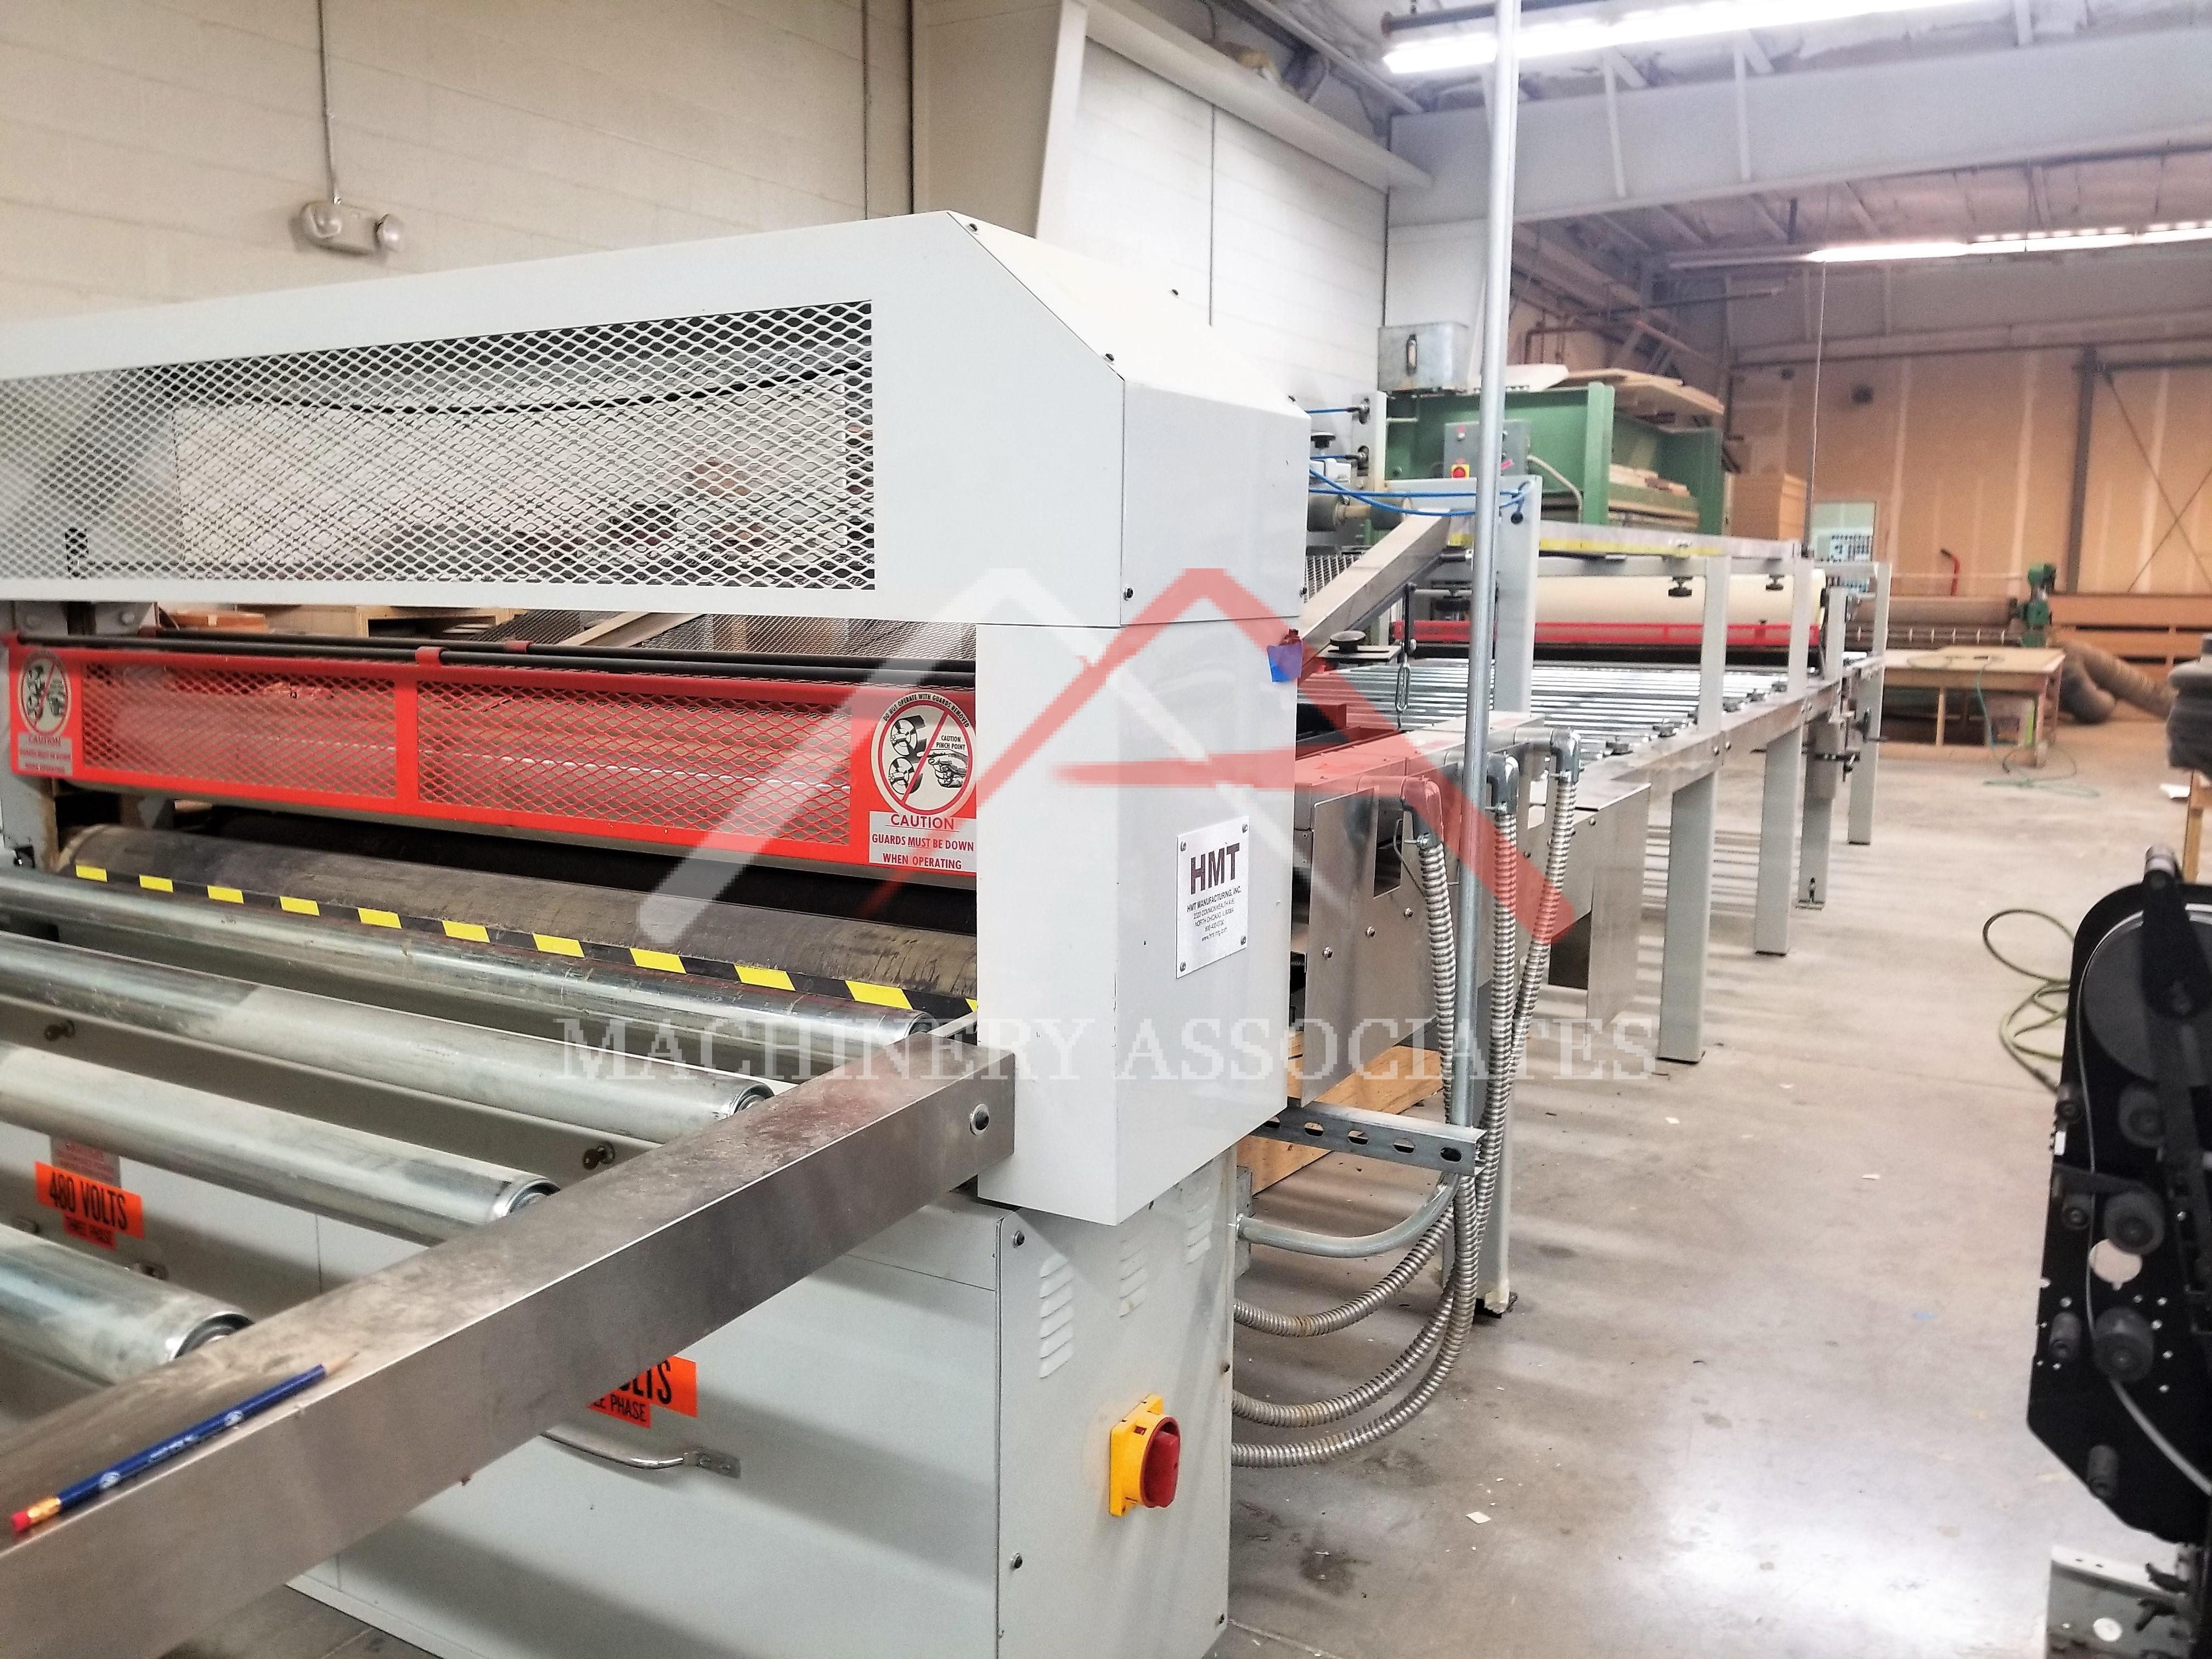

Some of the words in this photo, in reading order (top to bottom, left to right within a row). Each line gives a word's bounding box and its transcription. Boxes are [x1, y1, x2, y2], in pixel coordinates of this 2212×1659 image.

[883, 713, 890, 721] DO
[898, 693, 917, 707] OPERATE
[933, 695, 952, 708] GUARDS
[951, 705, 969, 727] REMOVED
[890, 814, 954, 830] CAUTION
[872, 834, 906, 845] GUARDS
[908, 837, 931, 848] MUST
[933, 839, 943, 849] BE
[945, 840, 974, 851] DOWN
[883, 853, 909, 865] WHEN
[912, 856, 962, 869] OPERATING
[1190, 843, 1240, 895] HMT
[1187, 902, 1197, 912] HMT
[1198, 889, 1233, 909] MANUFACTURING,
[81, 1181, 127, 1230] VOLTS
[610, 1394, 646, 1422] PHASE
